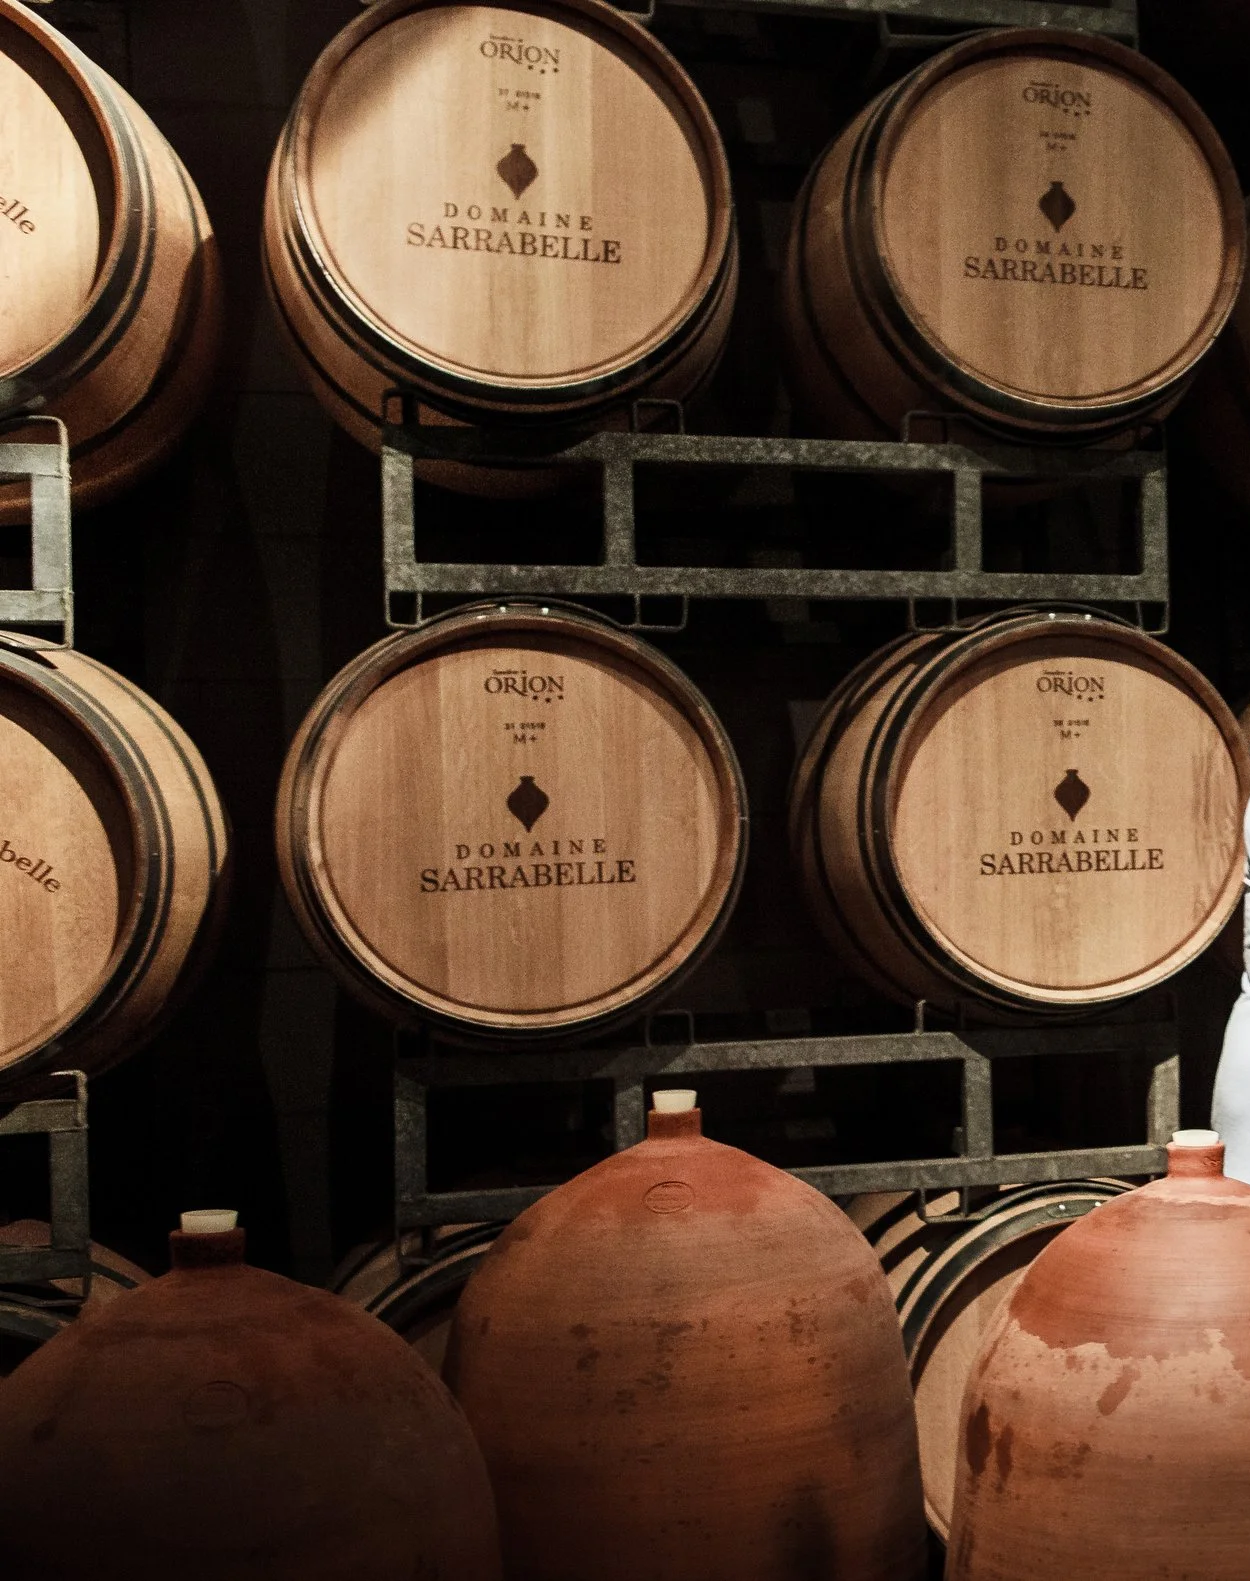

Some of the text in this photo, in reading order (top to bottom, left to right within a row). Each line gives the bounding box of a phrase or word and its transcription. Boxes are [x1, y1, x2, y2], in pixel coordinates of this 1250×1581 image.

[443, 202, 593, 231] DOMAINE
[406, 222, 622, 264] SARRABELLE
[994, 237, 1124, 260] DOMAINE
[963, 256, 1149, 290] SARRABELLE
[455, 839, 607, 860] DOMAINE
[1010, 828, 1139, 846] DOMAINE
[980, 848, 1165, 876] SARRABELLE
[420, 860, 636, 893] SARRABELLE
